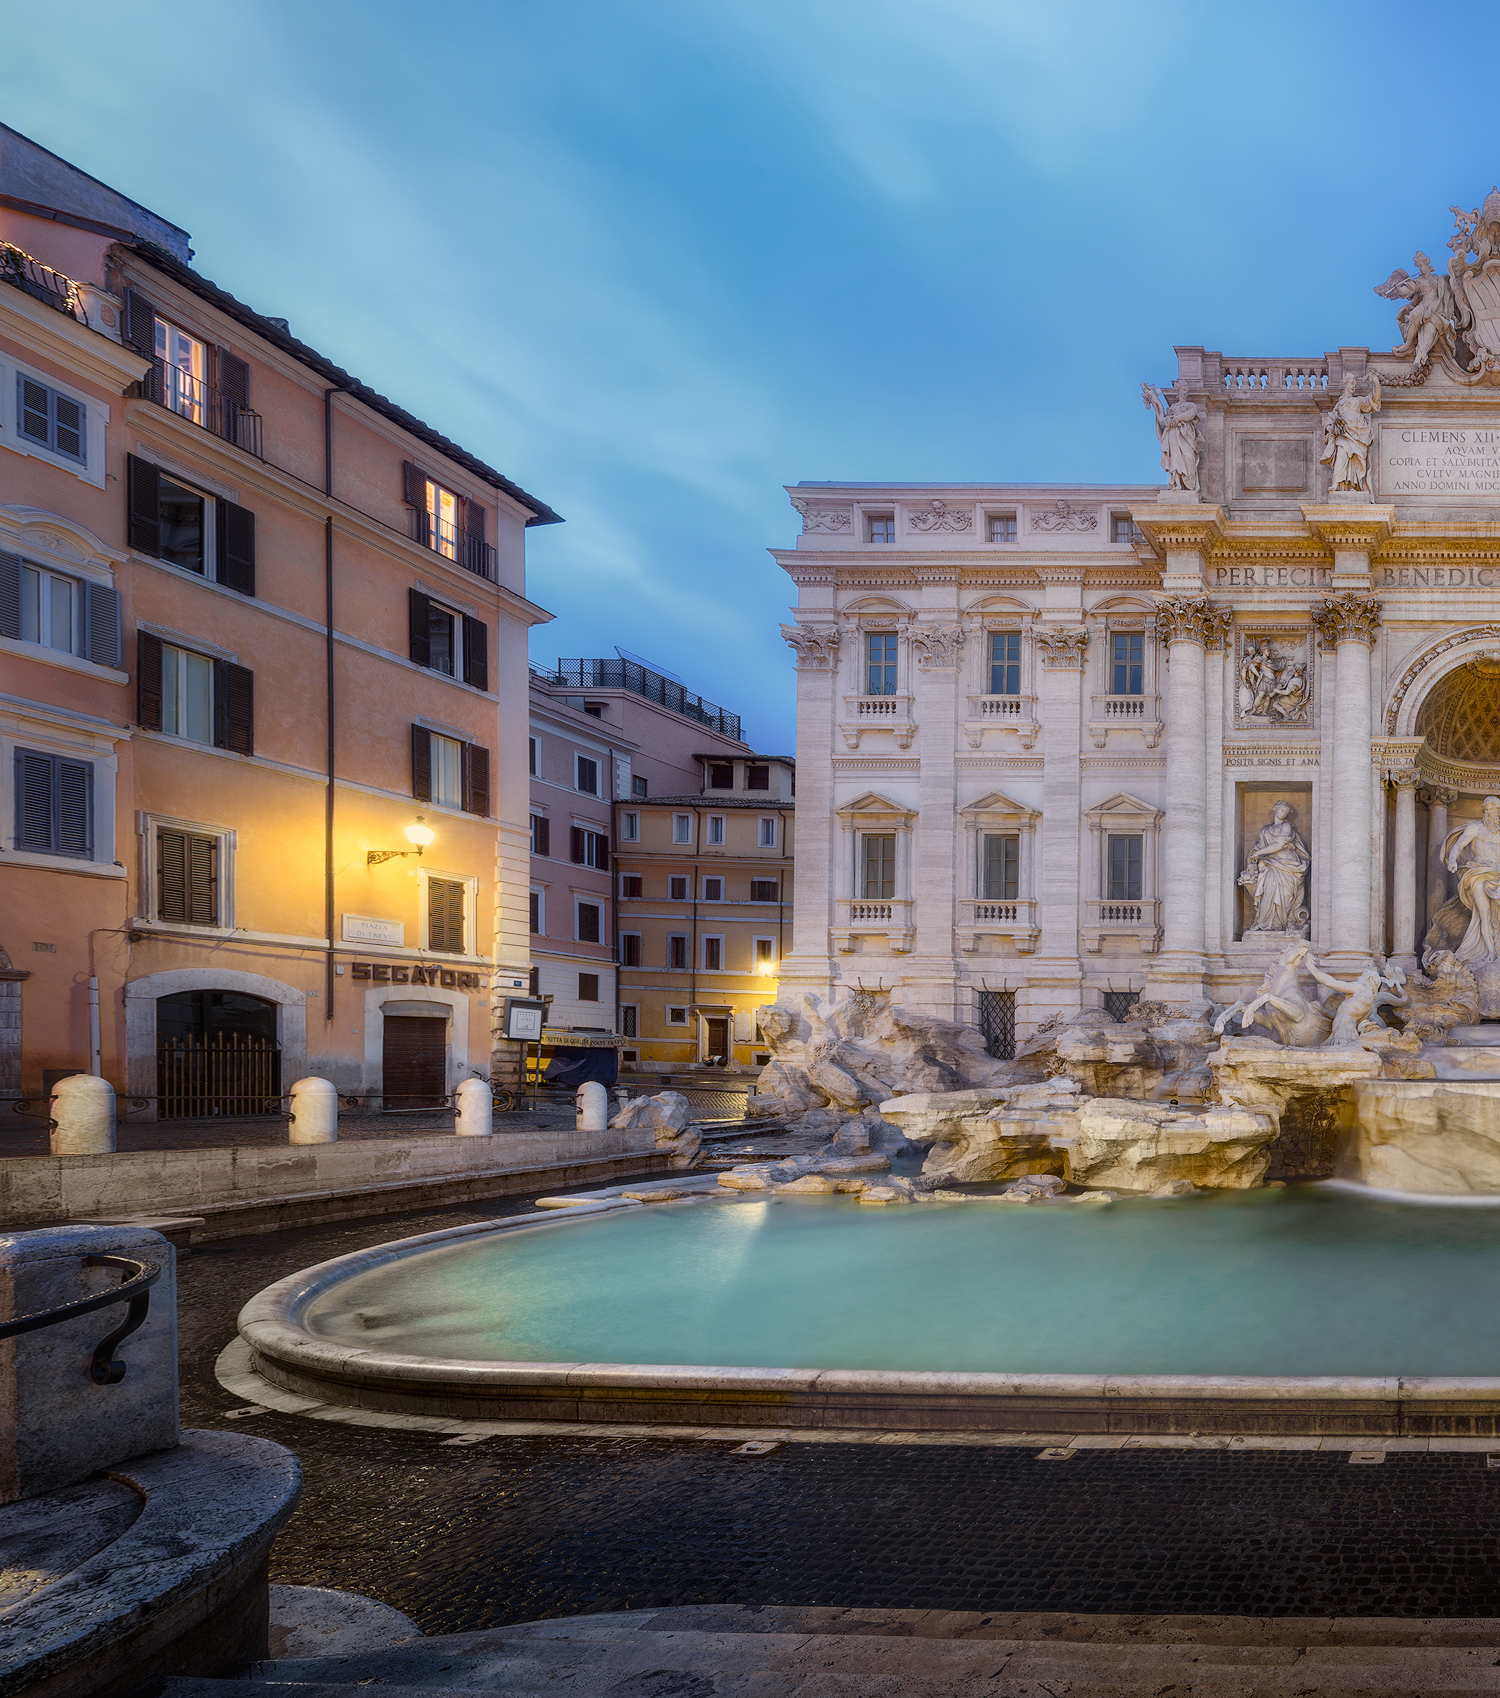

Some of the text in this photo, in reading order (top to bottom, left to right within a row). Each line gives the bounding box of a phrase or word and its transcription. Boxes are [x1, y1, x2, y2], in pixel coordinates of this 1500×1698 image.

[1401, 431, 1466, 443] CLEMENS
[1445, 446, 1485, 457] AQVAM
[1389, 457, 1421, 466] COPIA
[1426, 457, 1438, 466] ET
[1416, 469, 1452, 479] CVLTV
[1393, 481, 1426, 490] ANNO
[1430, 481, 1470, 490] DOMINI
[1215, 567, 1332, 586] PERFECIT
[1226, 758, 1254, 766] POSITIS
[1257, 758, 1282, 766] SIGNIS
[1286, 758, 1296, 766] ET
[361, 922, 388, 931] PIAZZA
[367, 931, 392, 940] TREVI
[352, 962, 479, 988] SEGATORI
